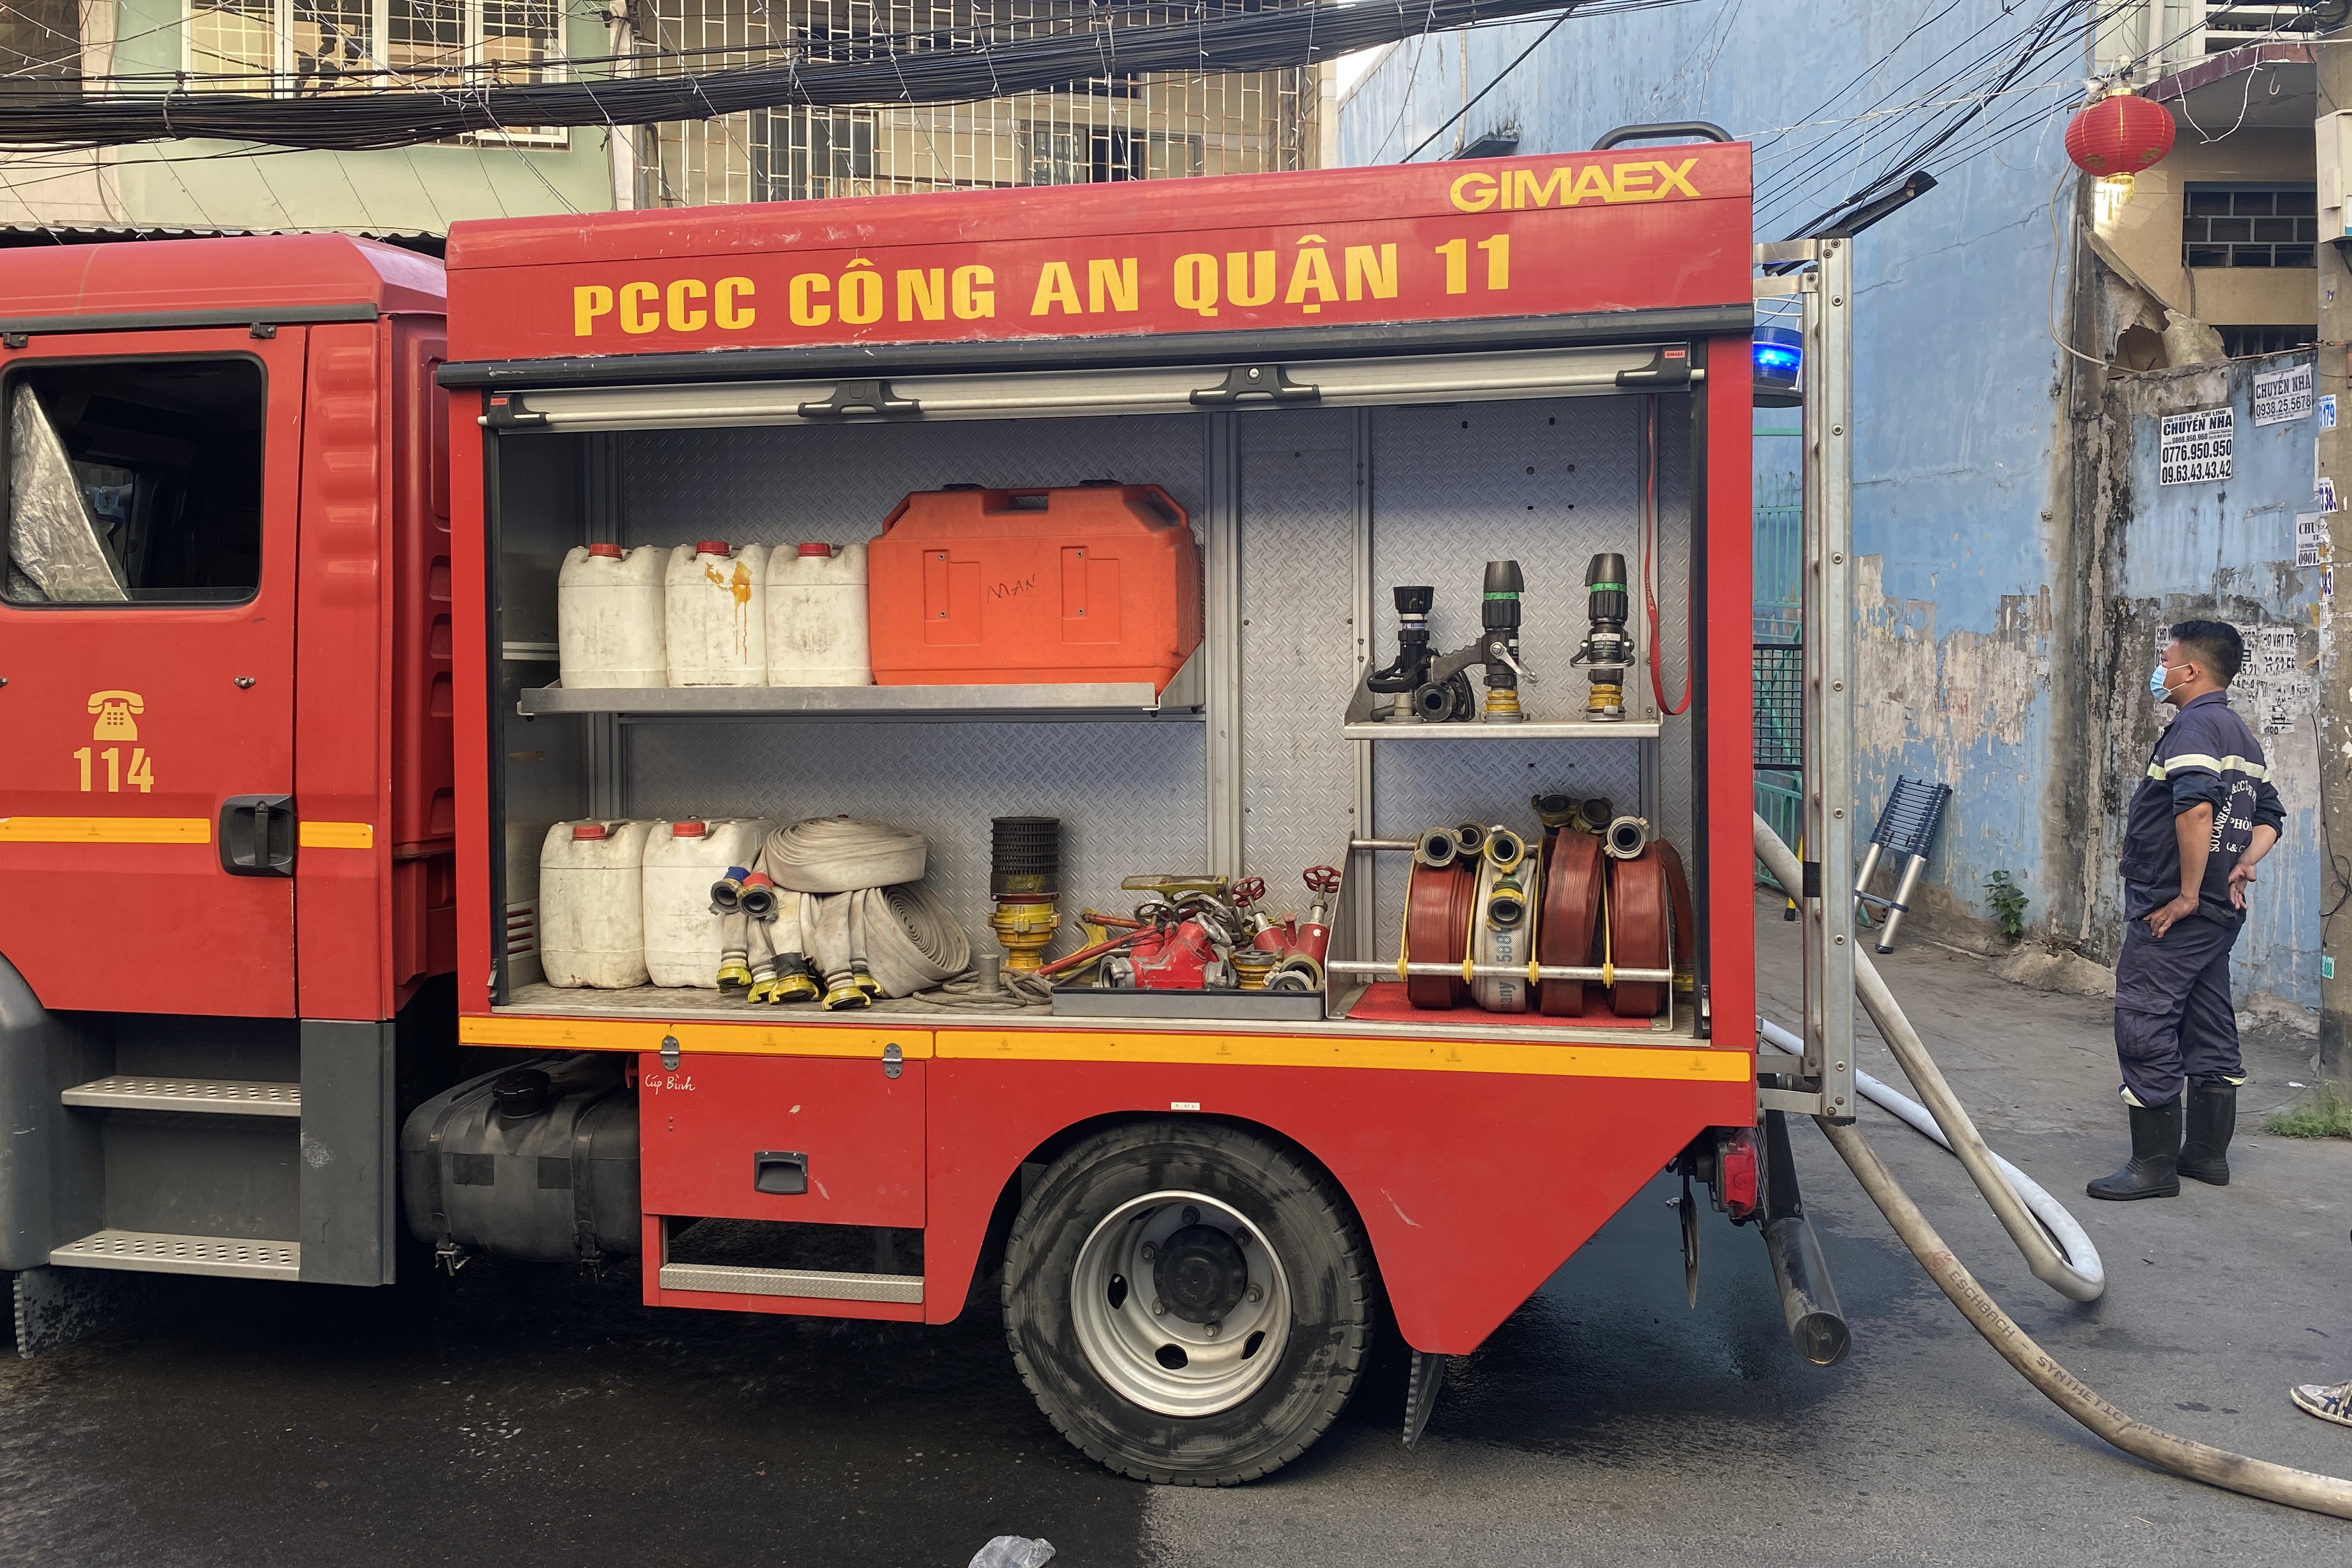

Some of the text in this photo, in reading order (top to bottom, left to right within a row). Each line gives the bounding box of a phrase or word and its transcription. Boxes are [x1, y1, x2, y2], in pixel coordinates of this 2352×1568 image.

[1449, 158, 1702, 212] GIMAEX
[574, 234, 1510, 337] PCCC CÔNG AN QUẬN 11
[2256, 370, 2311, 400] CHUYỂN NHÀ
[2256, 394, 2311, 417] 0938.25.5678
[2163, 415, 2206, 436] CHUYỂN
[2209, 413, 2233, 430] NHÀ
[2162, 439, 2232, 463] 0776.950.950
[2162, 459, 2231, 484] 09.63.43.43.42
[986, 574, 1036, 605] MAN
[2272, 633, 2285, 648] VAY
[73, 746, 155, 793] 114
[645, 1073, 696, 1096] Cúp Bình
[1949, 1271, 2015, 1338] ESCHBACH
[2036, 1355, 2125, 1422] SYNTHETIC
